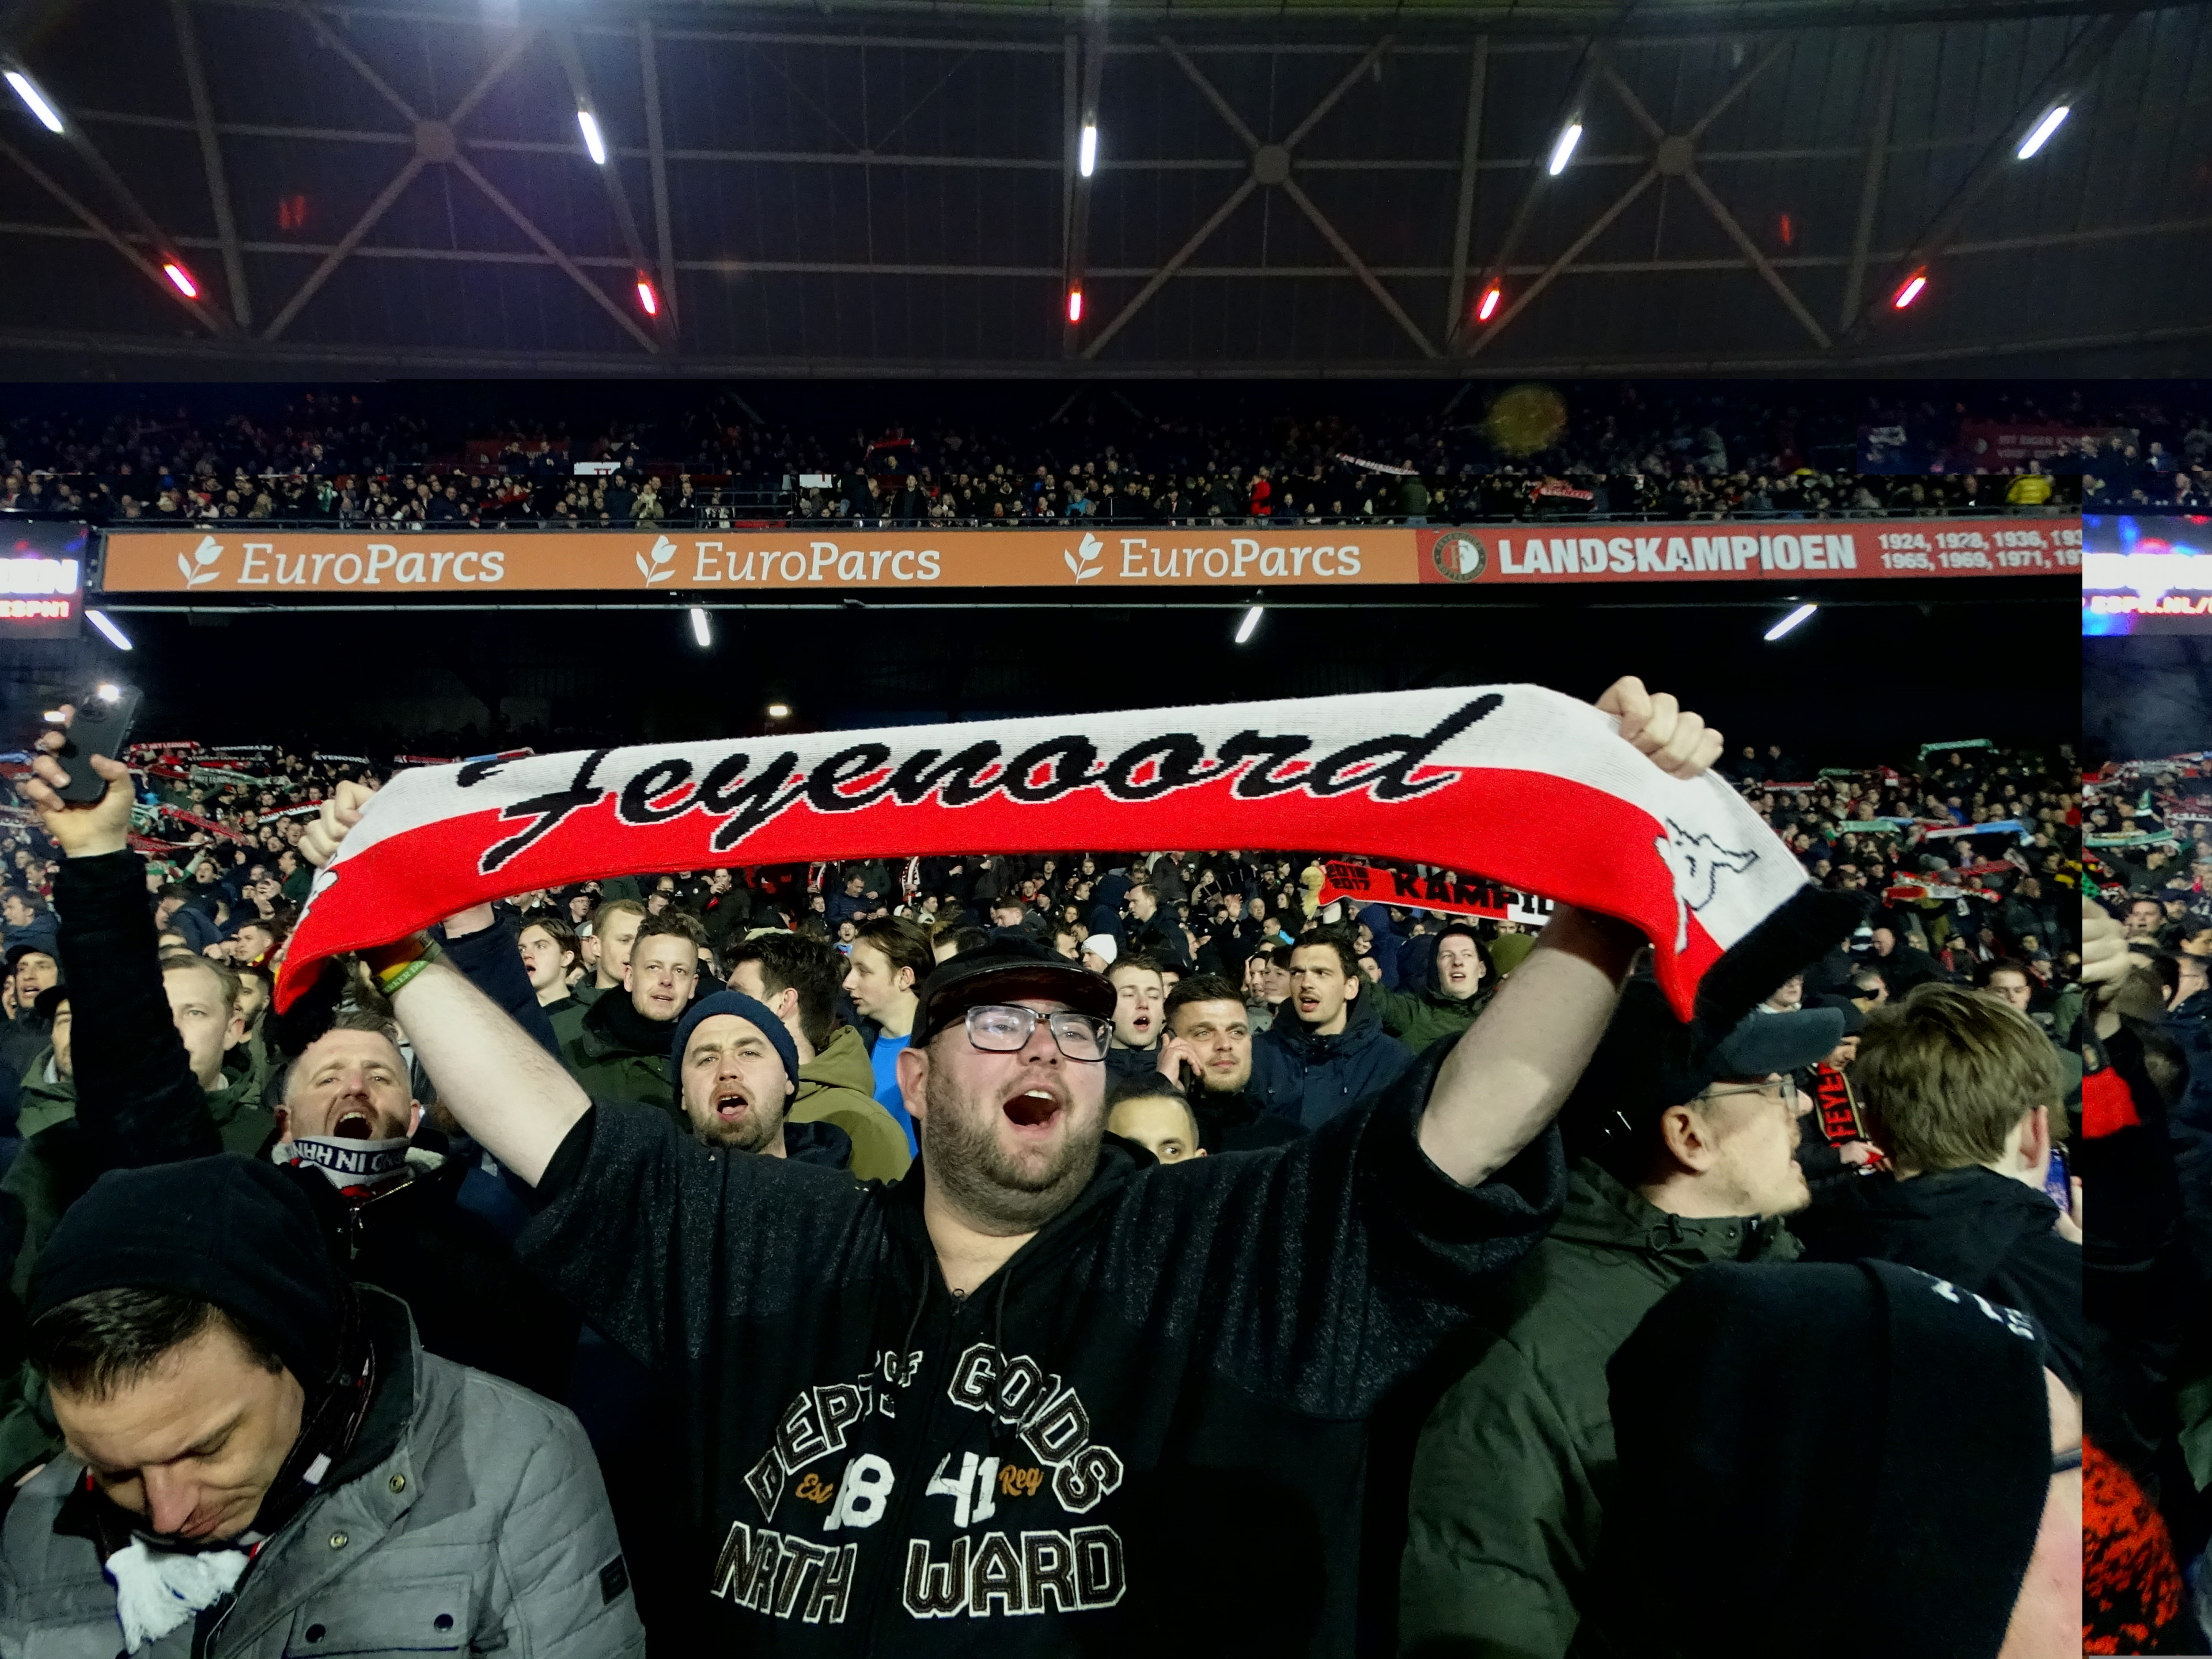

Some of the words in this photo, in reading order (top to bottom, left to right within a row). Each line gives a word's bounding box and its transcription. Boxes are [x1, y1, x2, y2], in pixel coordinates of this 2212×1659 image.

[693, 541, 941, 581] EuroParcs
[1120, 538, 1361, 577] EuroParcs
[1498, 535, 1857, 574] LANDSKAMPIOEN
[1878, 533, 1931, 552] 1924,
[1996, 550, 2051, 569] 1971,
[237, 543, 505, 584] EuroParcs
[2090, 596, 2212, 614] ESPN.NL/
[457, 693, 1505, 873] Feyenoord
[1330, 878, 1369, 891] 2017
[292, 1142, 333, 1166] HAN
[823, 1453, 895, 1531] 18
[925, 1451, 1000, 1528] 41
[903, 1525, 1126, 1618] WARD
